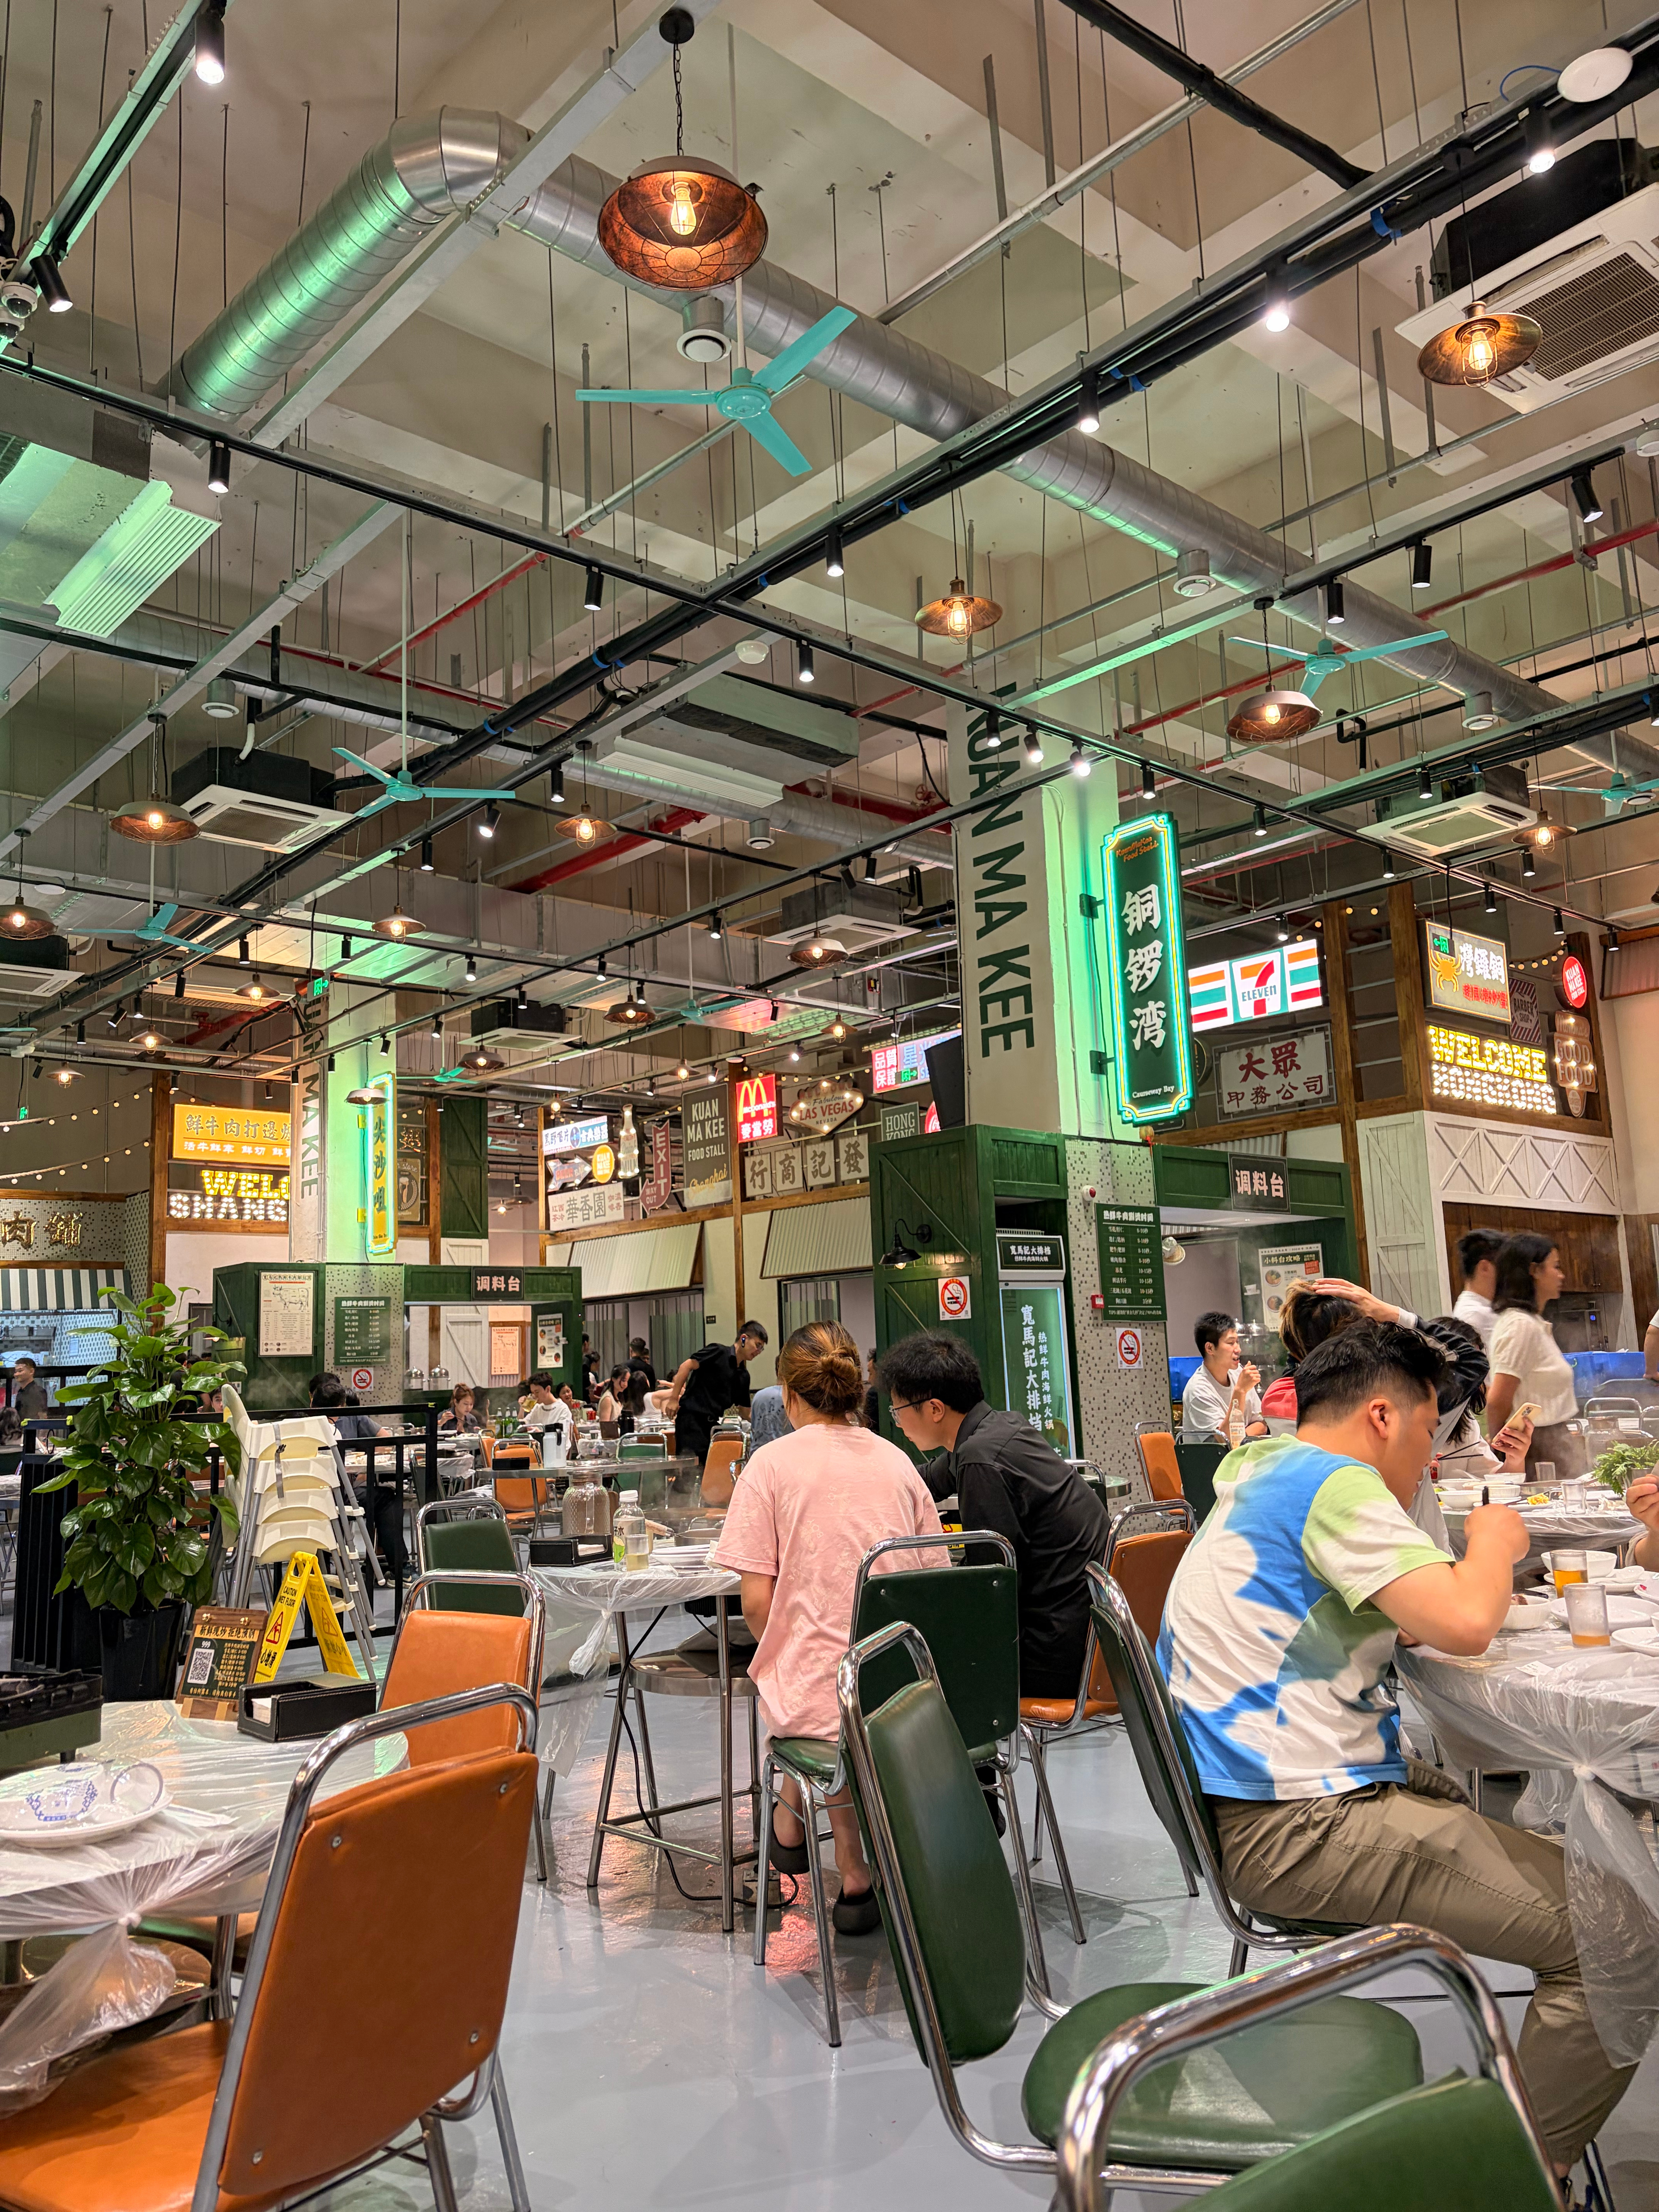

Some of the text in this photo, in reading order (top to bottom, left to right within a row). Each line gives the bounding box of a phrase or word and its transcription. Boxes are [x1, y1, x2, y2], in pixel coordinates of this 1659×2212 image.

[973, 841, 1028, 941] MA
[1121, 883, 1166, 1051] 铜锣湾
[1565, 963, 1580, 982] KUAN
[1242, 985, 1277, 1002] ELEVEN
[1568, 974, 1583, 993] MA KEE
[977, 944, 1035, 1058] KEE
[1513, 997, 1535, 1018] BARBER
[1519, 1012, 1530, 1024] SHOP
[1429, 1025, 1547, 1083] WELCOME
[1555, 1038, 1590, 1064] GOOD
[1239, 1041, 1302, 1084] 大眾
[1558, 1063, 1592, 1086] FOOD
[1163, 1084, 1175, 1094] Bay
[1227, 1074, 1323, 1109] 印務公司
[302, 1072, 319, 1128] MA
[692, 1098, 719, 1122] KUAN
[743, 1101, 776, 1114] McDonald's
[800, 1100, 854, 1121] LAS VEGAS
[812, 1095, 845, 1106] Fabulous
[687, 1117, 725, 1143] MA KEE
[741, 1118, 773, 1140] 麥當勞
[885, 1112, 915, 1132] HONG
[688, 1143, 725, 1162] FOOD STALL
[301, 1134, 319, 1199] KEE
[402, 1163, 418, 1173] store
[656, 1131, 668, 1196] EXIT
[645, 1186, 657, 1195] WAY
[688, 1163, 728, 1199] Shanghai
[1235, 1169, 1285, 1198] 调料台
[170, 1193, 287, 1222] SHANG
[646, 1195, 657, 1204] OUT
[476, 1276, 521, 1292] 调料台
[1038, 1331, 1055, 1430] 热鲜牛肉海鲜火锅
[807, 1519, 824, 1539] BOY
[847, 1555, 861, 1577] BOY
[283, 1585, 297, 1597] CAUTION
[285, 1597, 296, 1607] FLOOR
[260, 1648, 278, 1669] 心地滑
